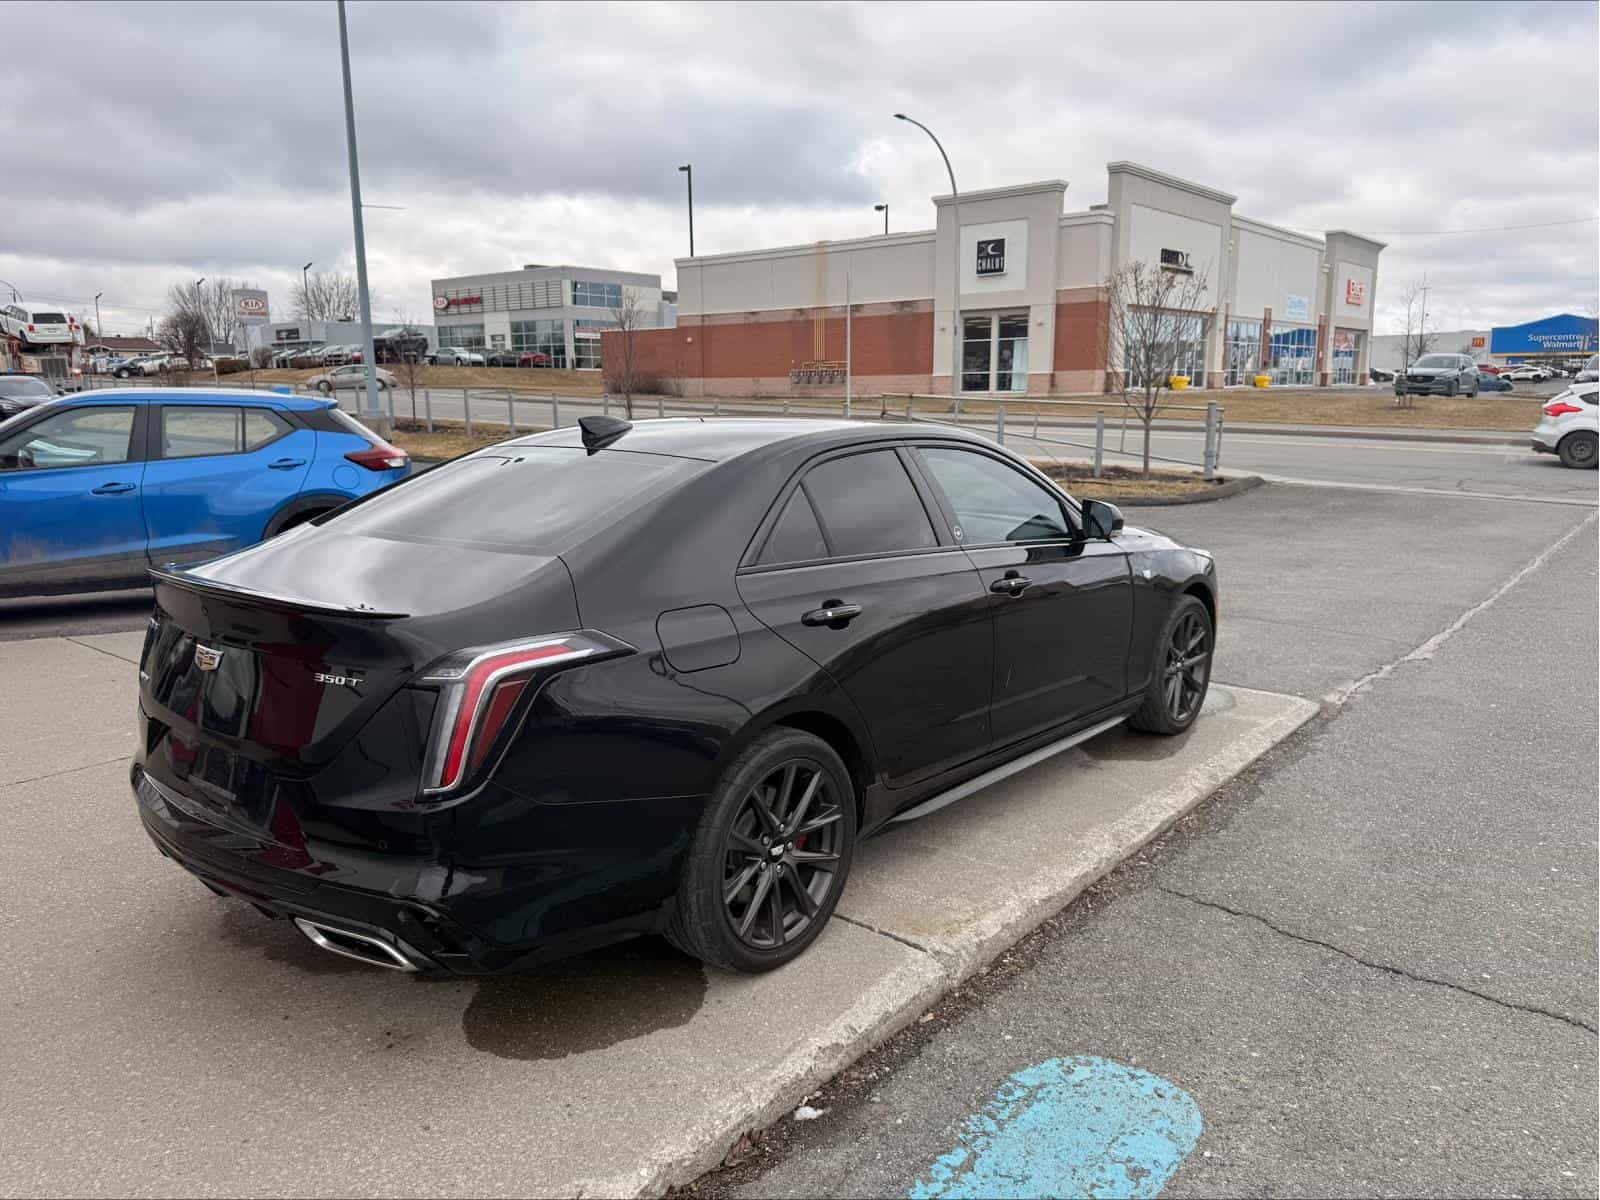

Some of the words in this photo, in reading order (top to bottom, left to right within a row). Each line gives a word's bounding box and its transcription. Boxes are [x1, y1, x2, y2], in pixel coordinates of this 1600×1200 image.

[243, 300, 260, 308] KIA
[1527, 333, 1582, 343] Supercentre
[1542, 341, 1582, 349] Walmart
[313, 671, 364, 687] 350T
